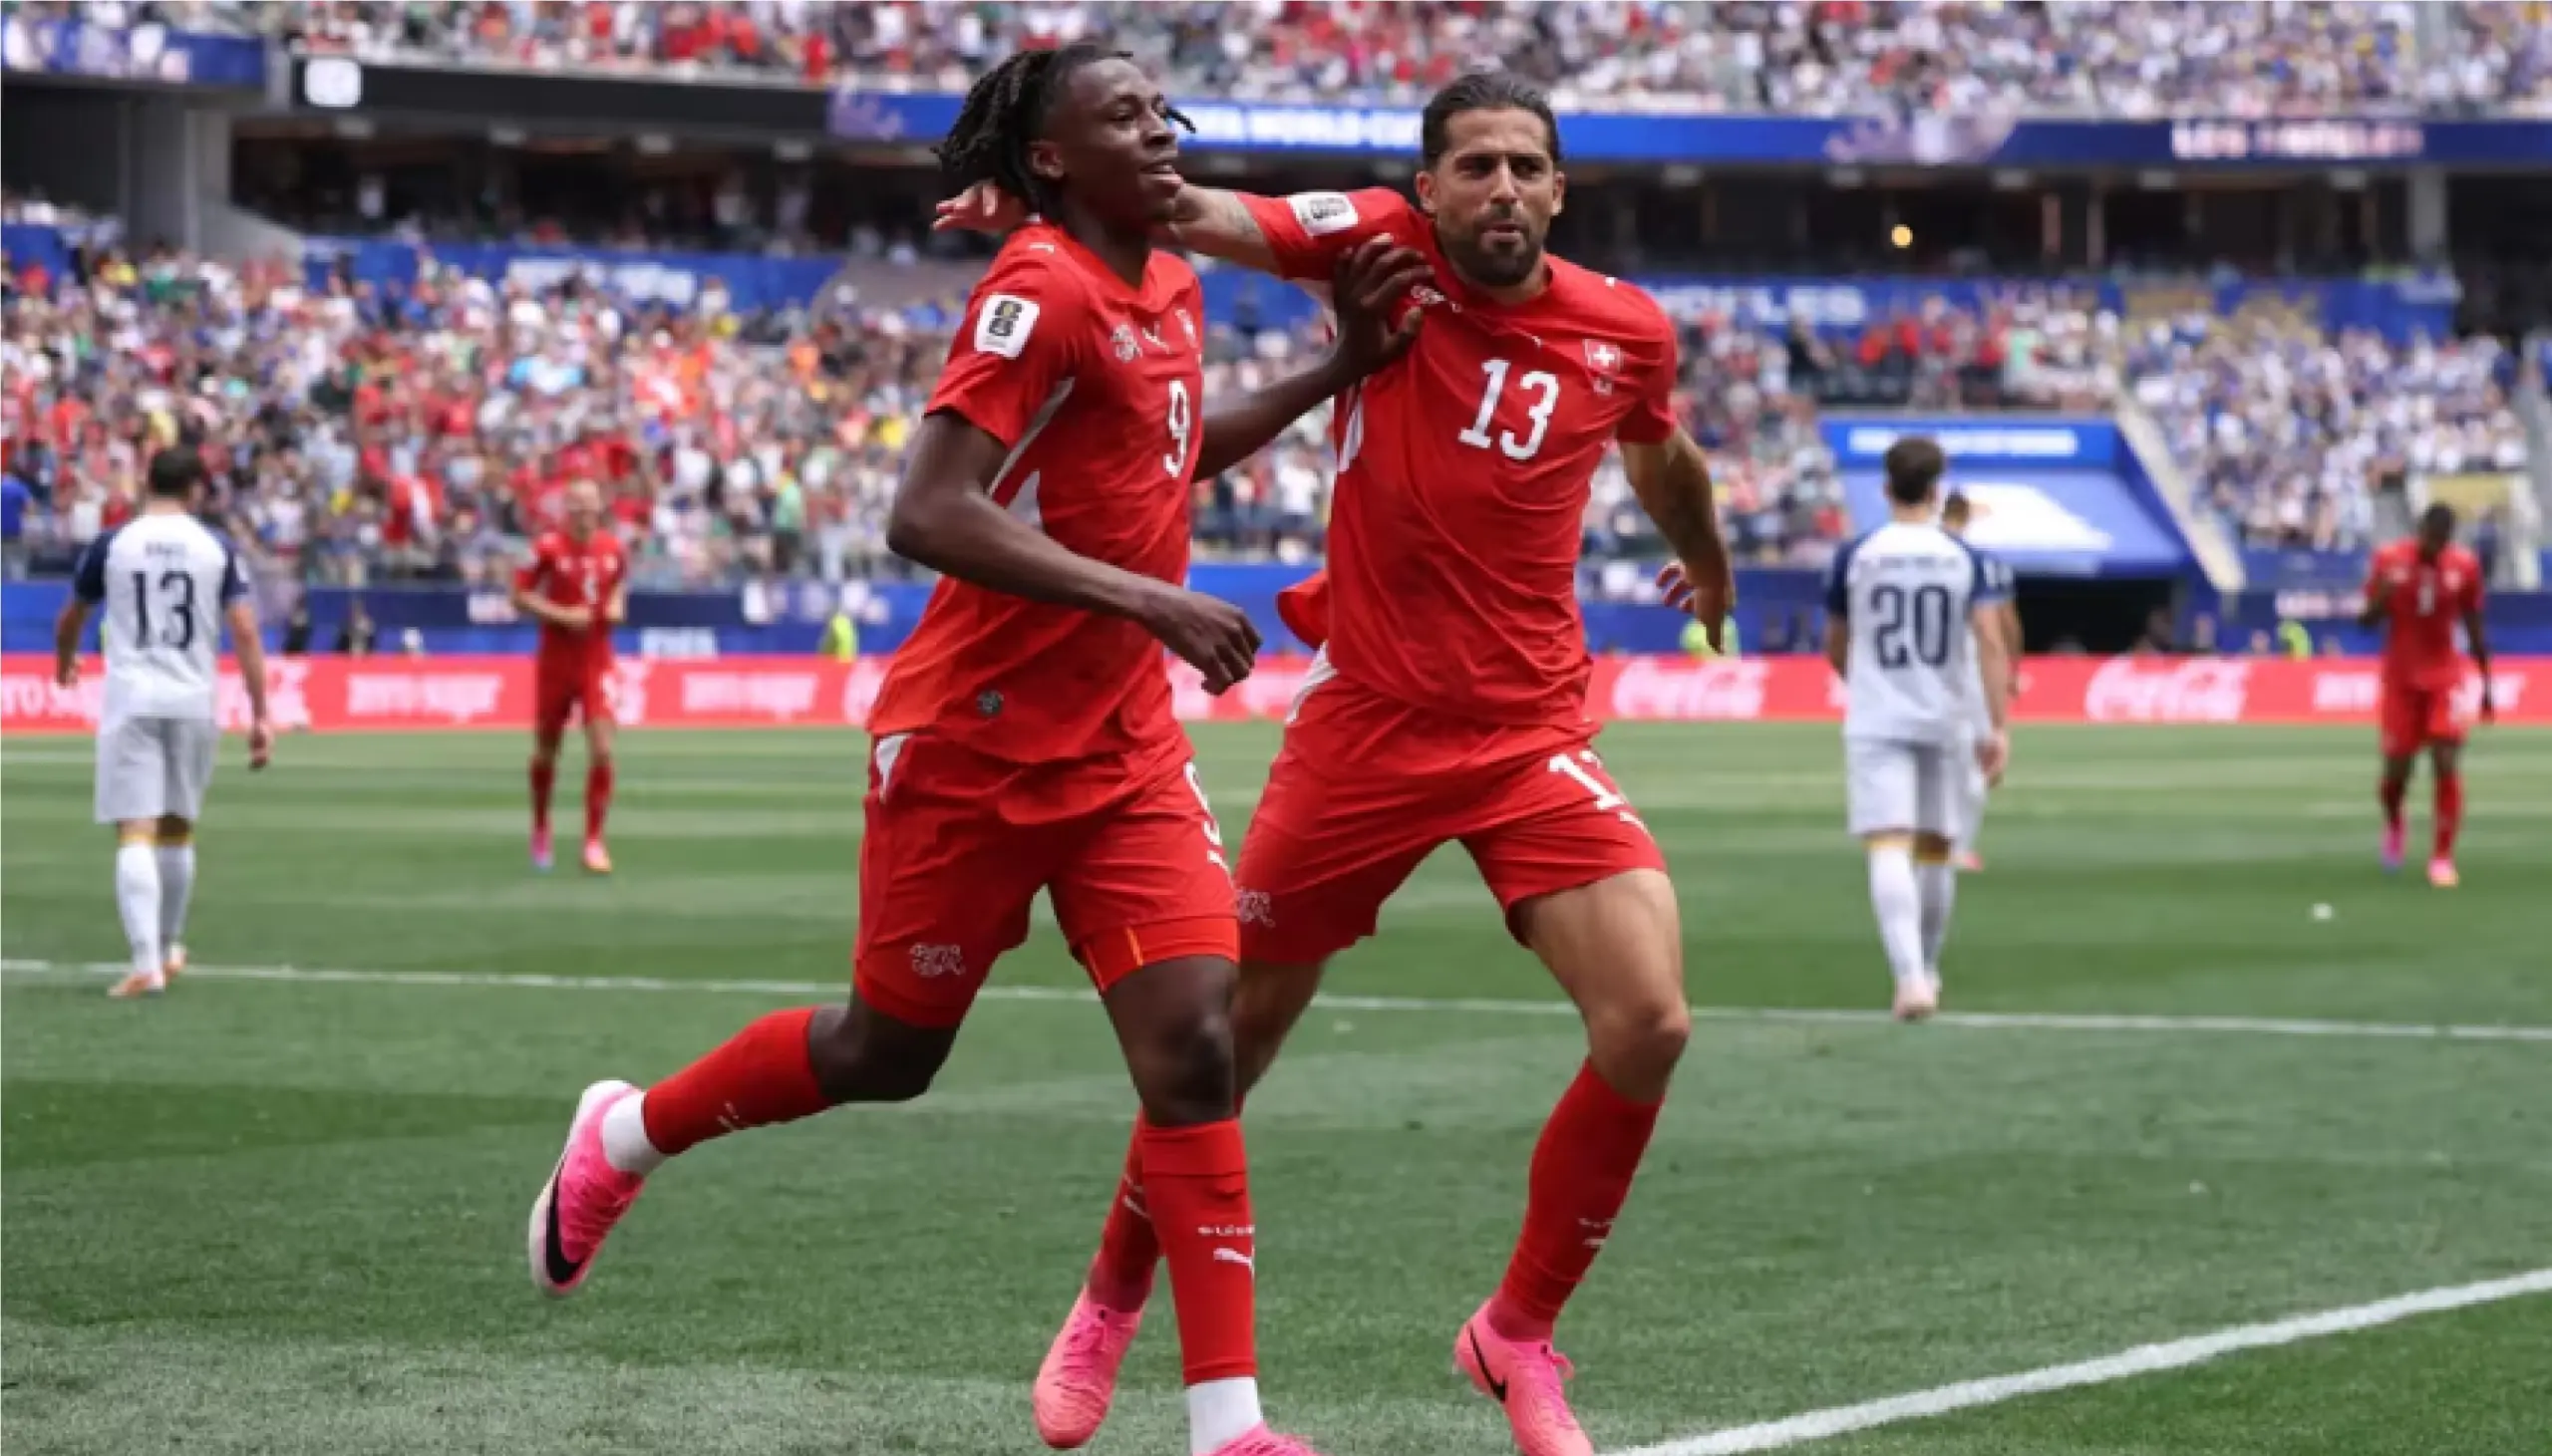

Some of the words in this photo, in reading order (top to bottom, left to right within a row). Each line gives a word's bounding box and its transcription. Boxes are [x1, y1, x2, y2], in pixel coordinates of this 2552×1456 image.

[1163, 379, 1190, 479] 9
[1458, 359, 1561, 460] 13
[132, 570, 195, 652] 13
[1869, 584, 1951, 670] 20
[2085, 656, 2252, 722] Coca-Cola
